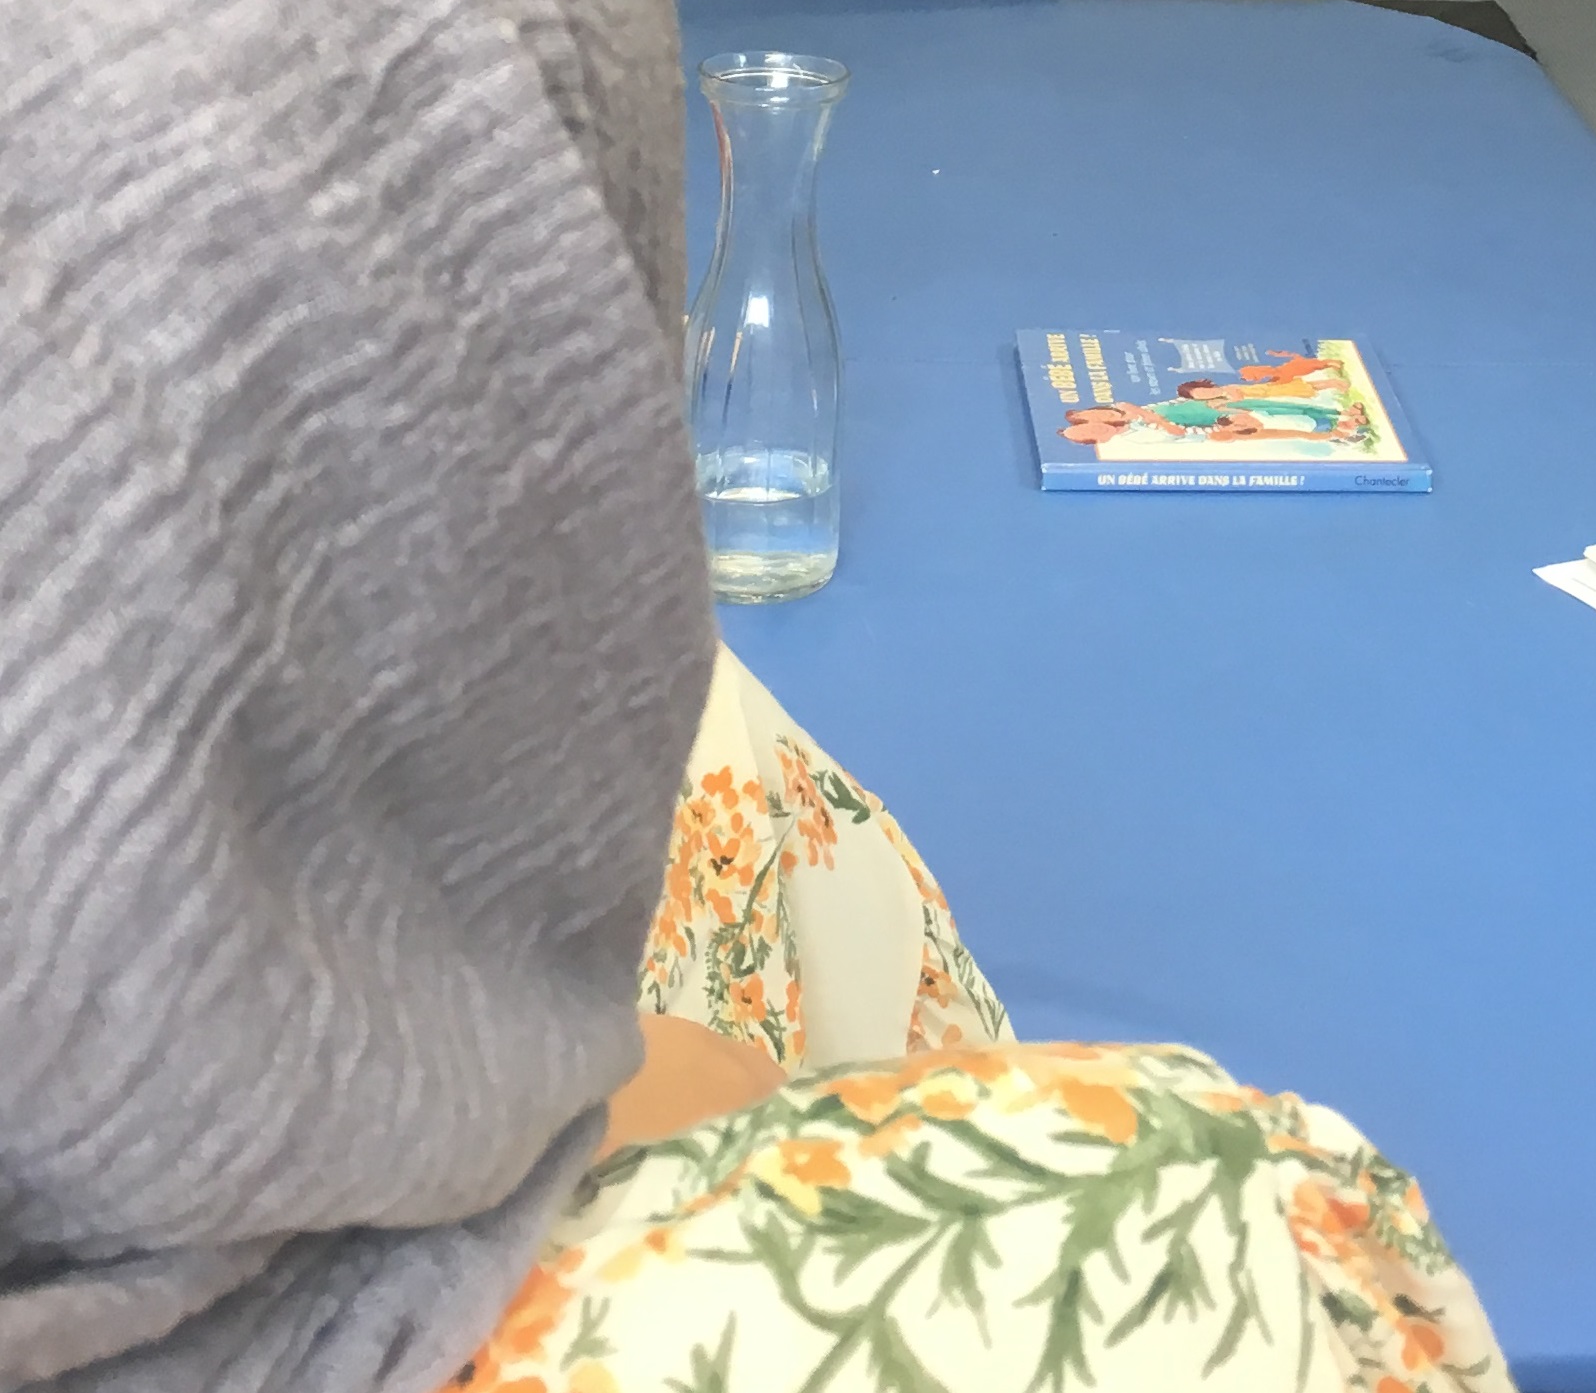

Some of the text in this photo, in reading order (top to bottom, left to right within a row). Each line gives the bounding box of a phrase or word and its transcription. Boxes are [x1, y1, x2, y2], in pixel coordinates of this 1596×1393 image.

[1097, 474, 1115, 486] UN
[1117, 472, 1149, 486] BÉBÉ
[1151, 474, 1196, 486] ARRIVE
[1197, 474, 1230, 487] DANS
[1232, 475, 1247, 486] LA
[1354, 475, 1411, 487] Chantecler
